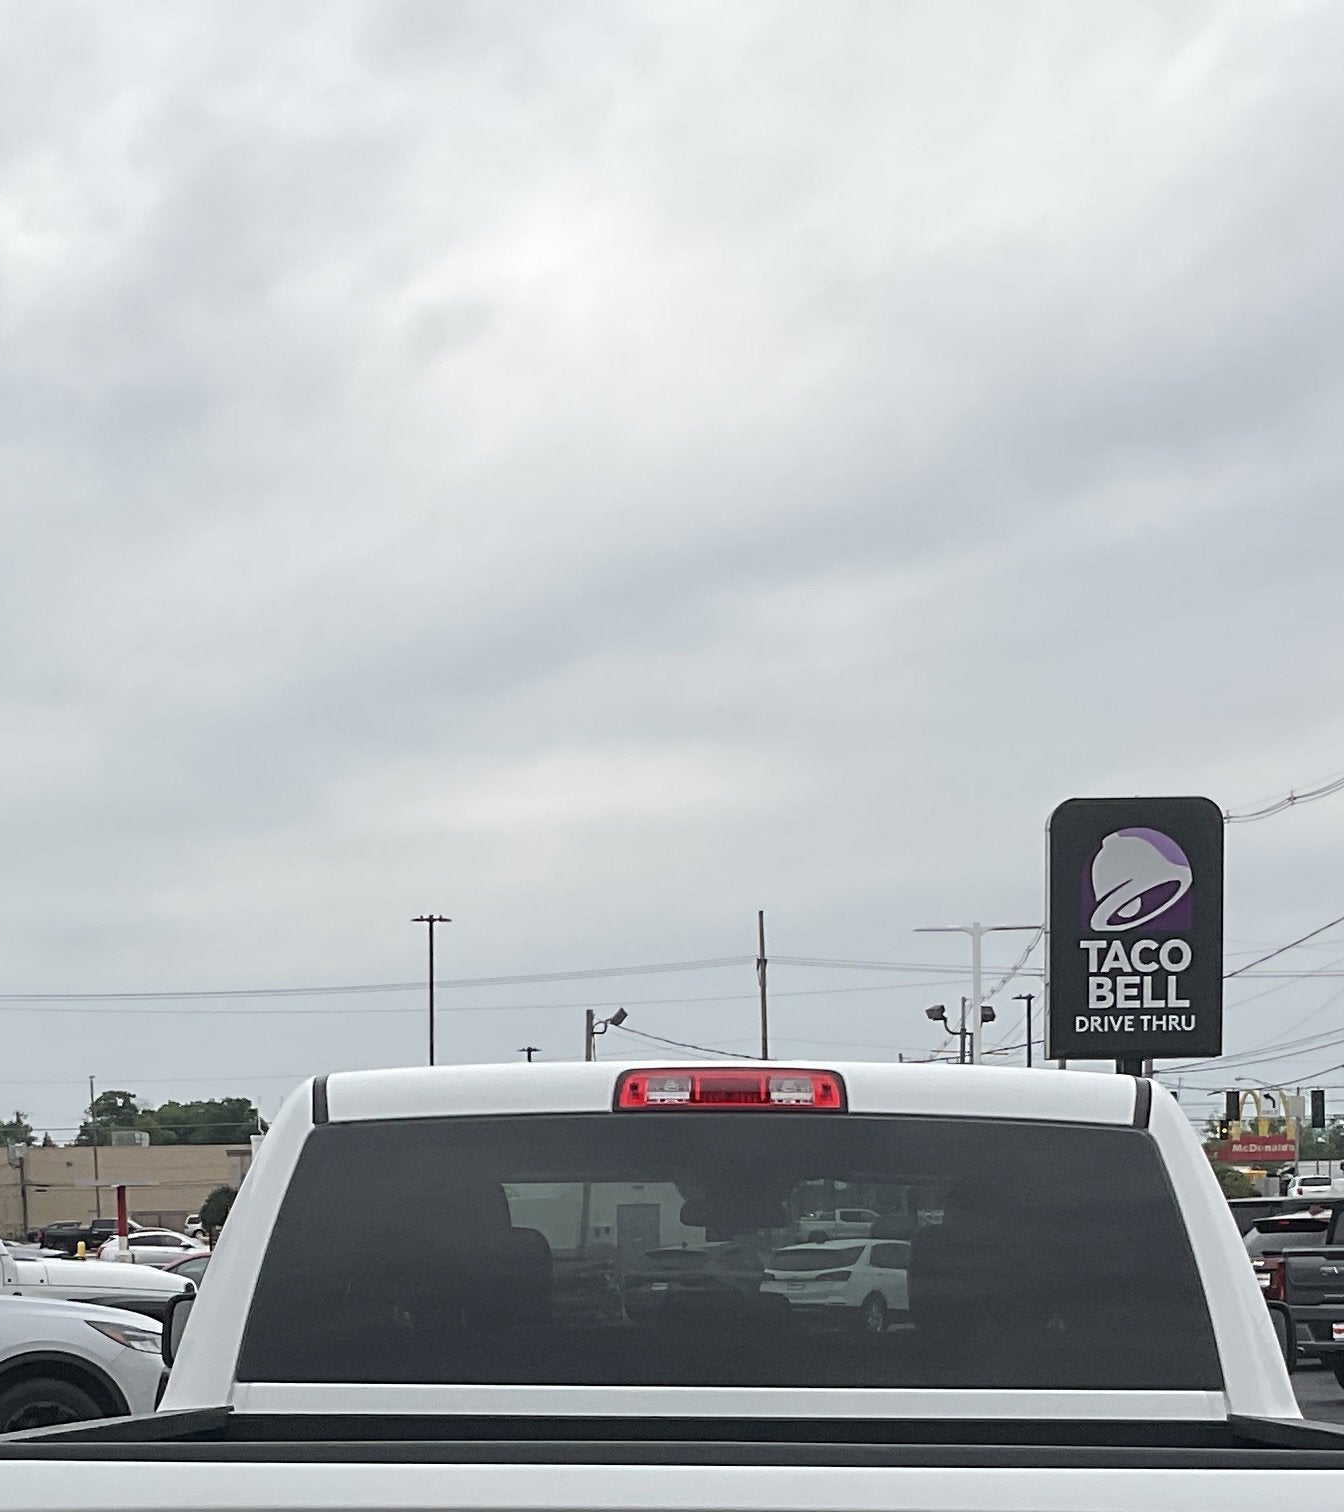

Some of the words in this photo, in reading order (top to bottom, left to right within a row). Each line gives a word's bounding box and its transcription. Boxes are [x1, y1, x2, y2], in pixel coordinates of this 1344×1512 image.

[1080, 939, 1192, 973] TACO
[1088, 975, 1190, 1009] BELL
[1075, 1015, 1134, 1032] DRIVE
[1139, 1014, 1196, 1032] THRU
[1232, 1142, 1296, 1154] McDonald's
